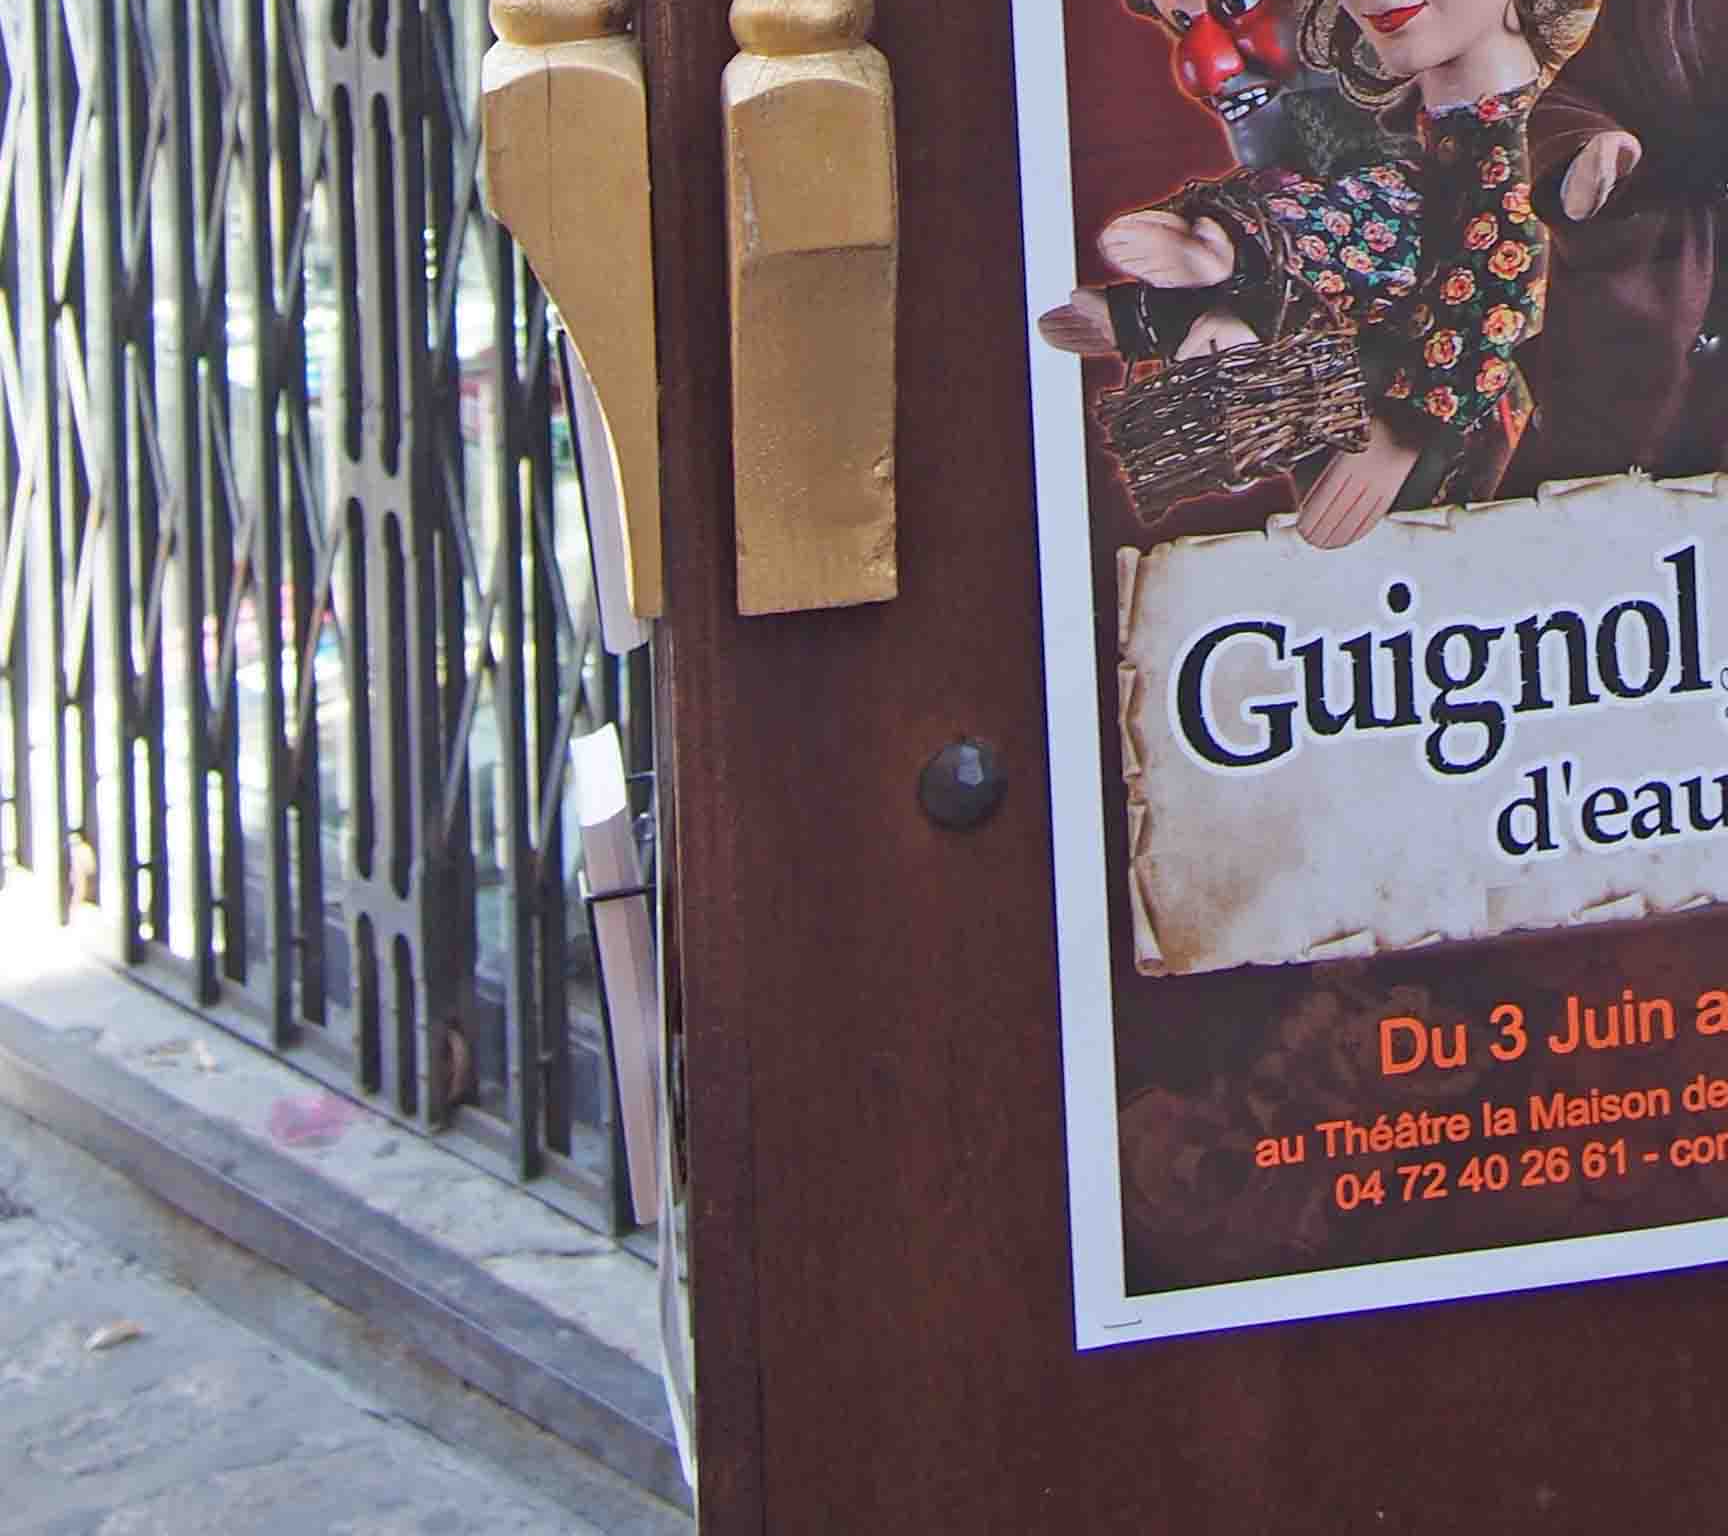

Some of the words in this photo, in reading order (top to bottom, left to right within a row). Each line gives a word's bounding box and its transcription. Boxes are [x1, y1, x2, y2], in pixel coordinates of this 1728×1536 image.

[1176, 545, 1714, 775] Guignol
[1379, 1018, 1467, 1076] Du
[1488, 1004, 1527, 1061] 3
[1548, 989, 1674, 1055] Juin
[1255, 1134, 1304, 1168] au
[1315, 1114, 1471, 1159] Théâtre
[1482, 1102, 1517, 1136] la
[1529, 1086, 1670, 1131] Maison
[1335, 1171, 1385, 1211] 04
[1398, 1161, 1449, 1203] 72
[1458, 1154, 1510, 1194] 40
[1521, 1146, 1570, 1187] 26
[1581, 1138, 1629, 1179] 61
